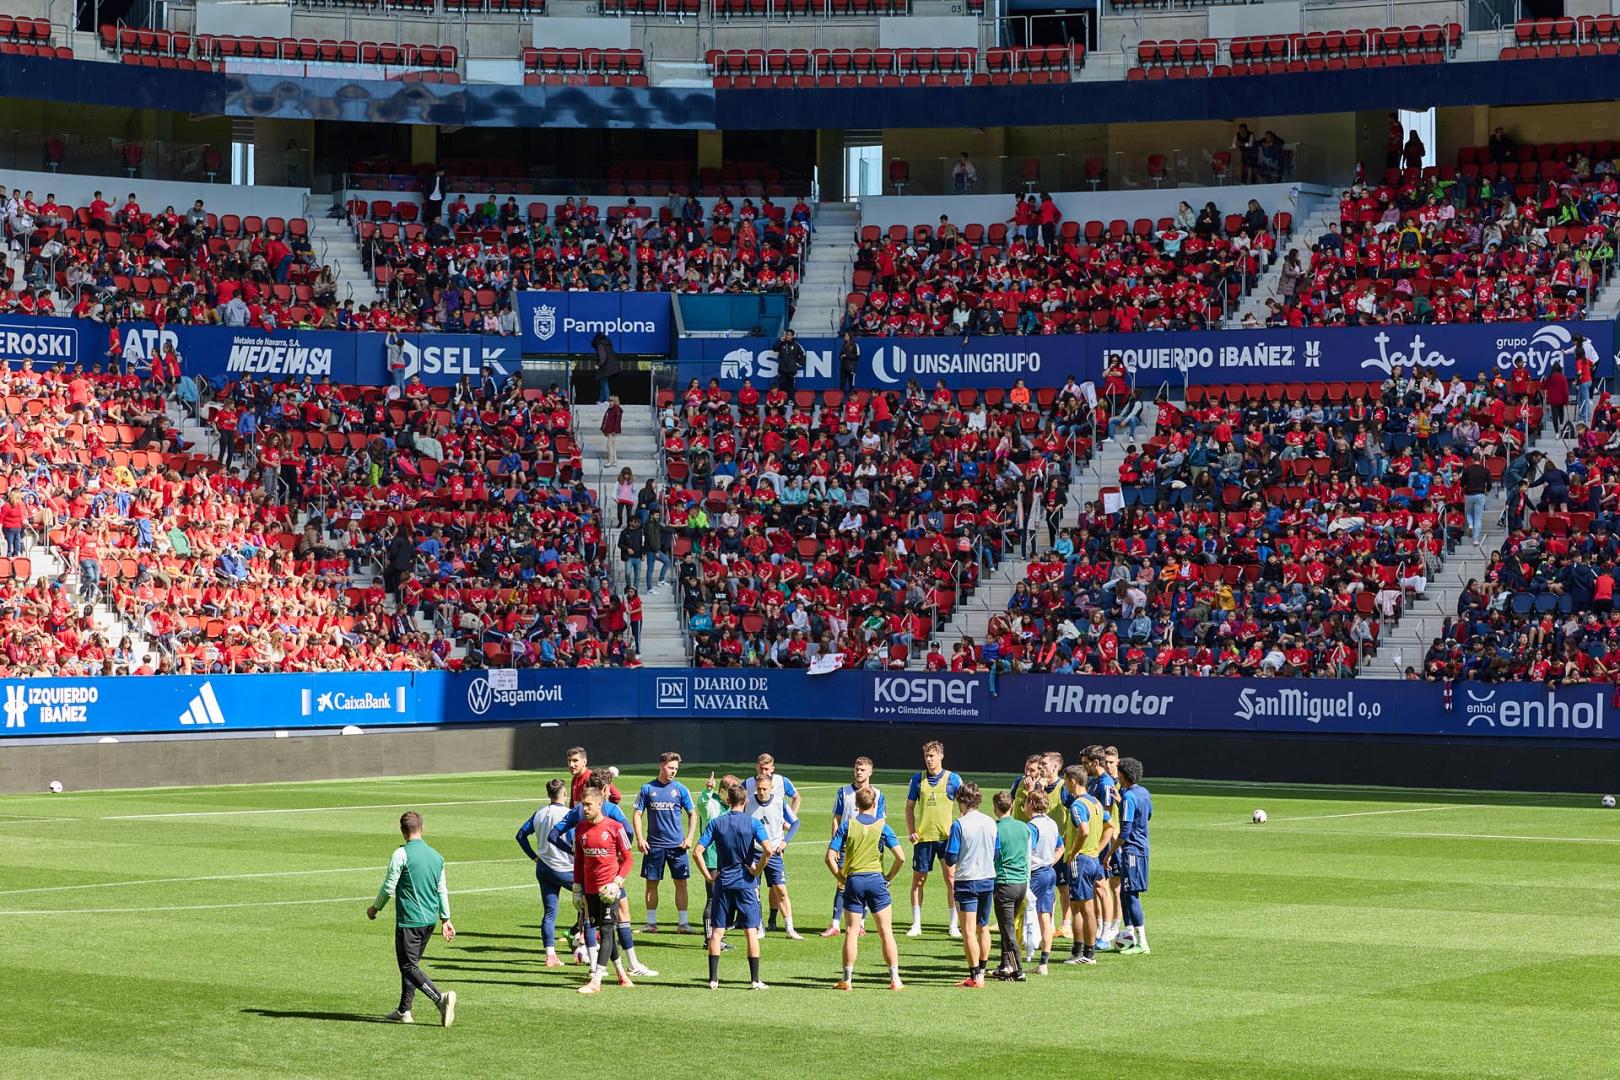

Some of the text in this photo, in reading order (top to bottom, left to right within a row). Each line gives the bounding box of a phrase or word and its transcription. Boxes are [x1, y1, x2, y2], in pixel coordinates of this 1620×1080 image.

[951, 5, 962, 13] 03
[563, 317, 655, 336] Pamplona
[233, 336, 301, 348] Metales de Navarra, S.A.
[1496, 338, 1528, 350] grupo
[423, 346, 509, 375] SELK
[757, 349, 833, 379] SN
[913, 352, 1041, 374] UNSAINGRUPO
[660, 683, 683, 696] DN
[694, 677, 769, 691] DIARIO DE
[334, 692, 392, 710] CaixaBank
[493, 684, 563, 707] Sagamóvil
[694, 694, 769, 710] NAVARRA
[897, 705, 979, 717] Climatización eficiente
[1466, 702, 1496, 714] enhol
[1500, 691, 1604, 729] enhol
